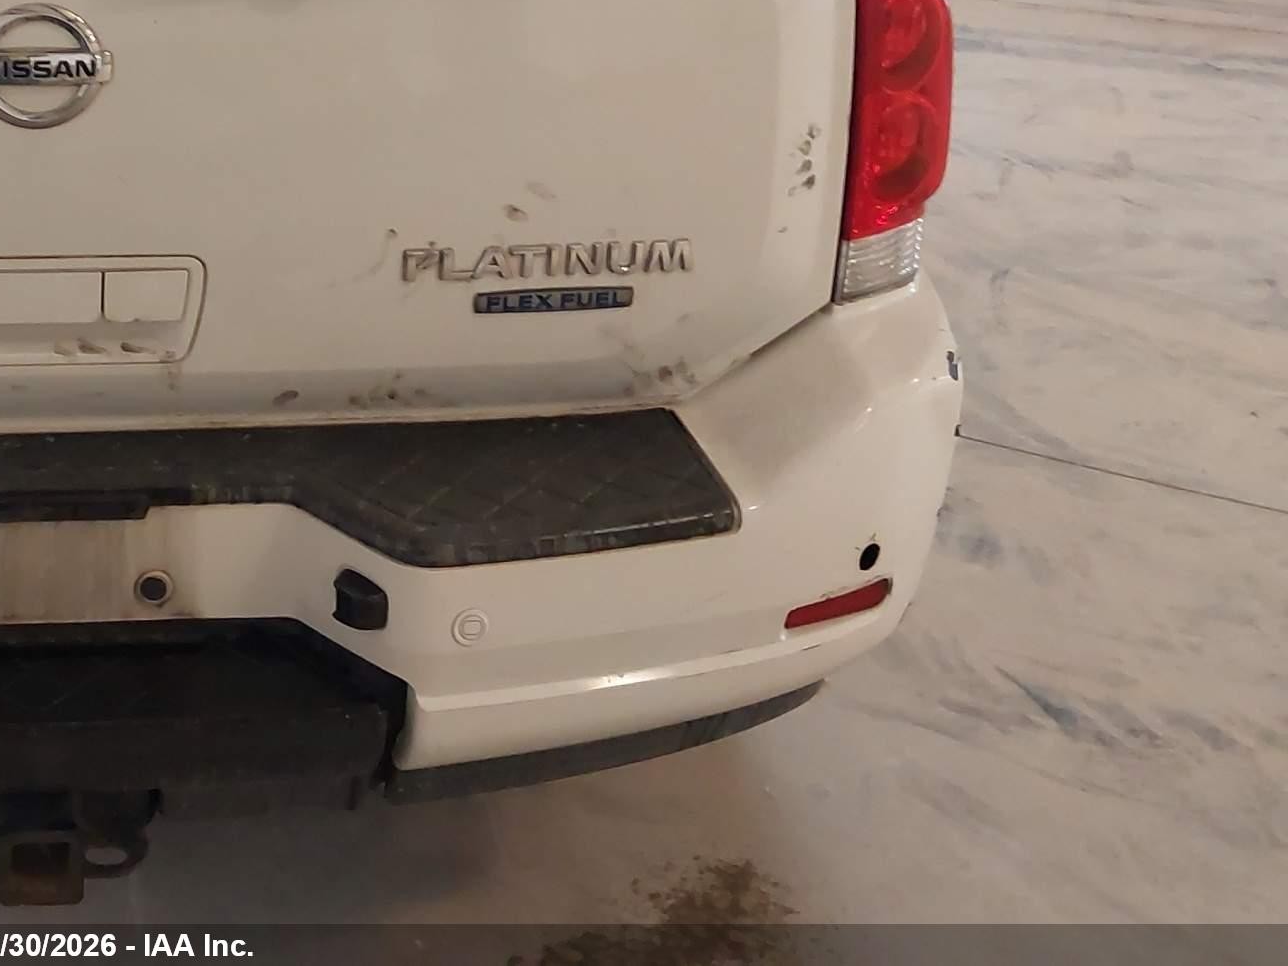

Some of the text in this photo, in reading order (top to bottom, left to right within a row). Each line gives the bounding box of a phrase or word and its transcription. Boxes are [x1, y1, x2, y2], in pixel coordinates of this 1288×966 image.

[401, 238, 692, 283] PLATINUM
[485, 290, 628, 312] FLEX FUEL
